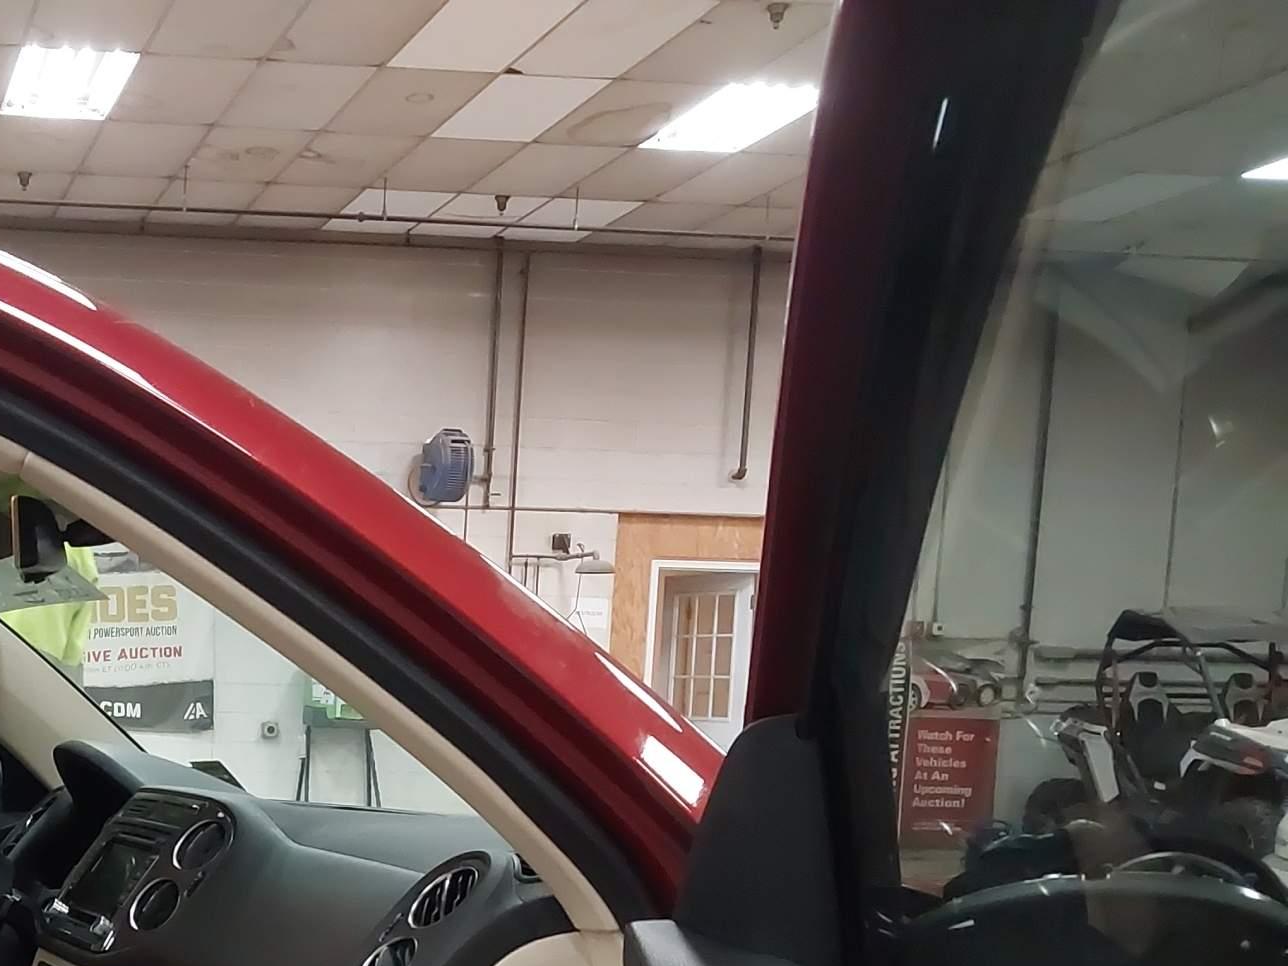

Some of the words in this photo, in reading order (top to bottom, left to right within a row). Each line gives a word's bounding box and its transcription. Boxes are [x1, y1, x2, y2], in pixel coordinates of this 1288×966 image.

[93, 628, 143, 639] POWERSPORT
[145, 625, 177, 637] AUCTION
[117, 646, 183, 661] AUCTION
[917, 730, 953, 742] Watch
[956, 730, 975, 742] For
[917, 743, 953, 754] These
[915, 756, 967, 769] Vehicles
[914, 770, 930, 781] At
[931, 770, 949, 781] An
[913, 783, 972, 798] Upcoming
[912, 797, 965, 809] Auction!
